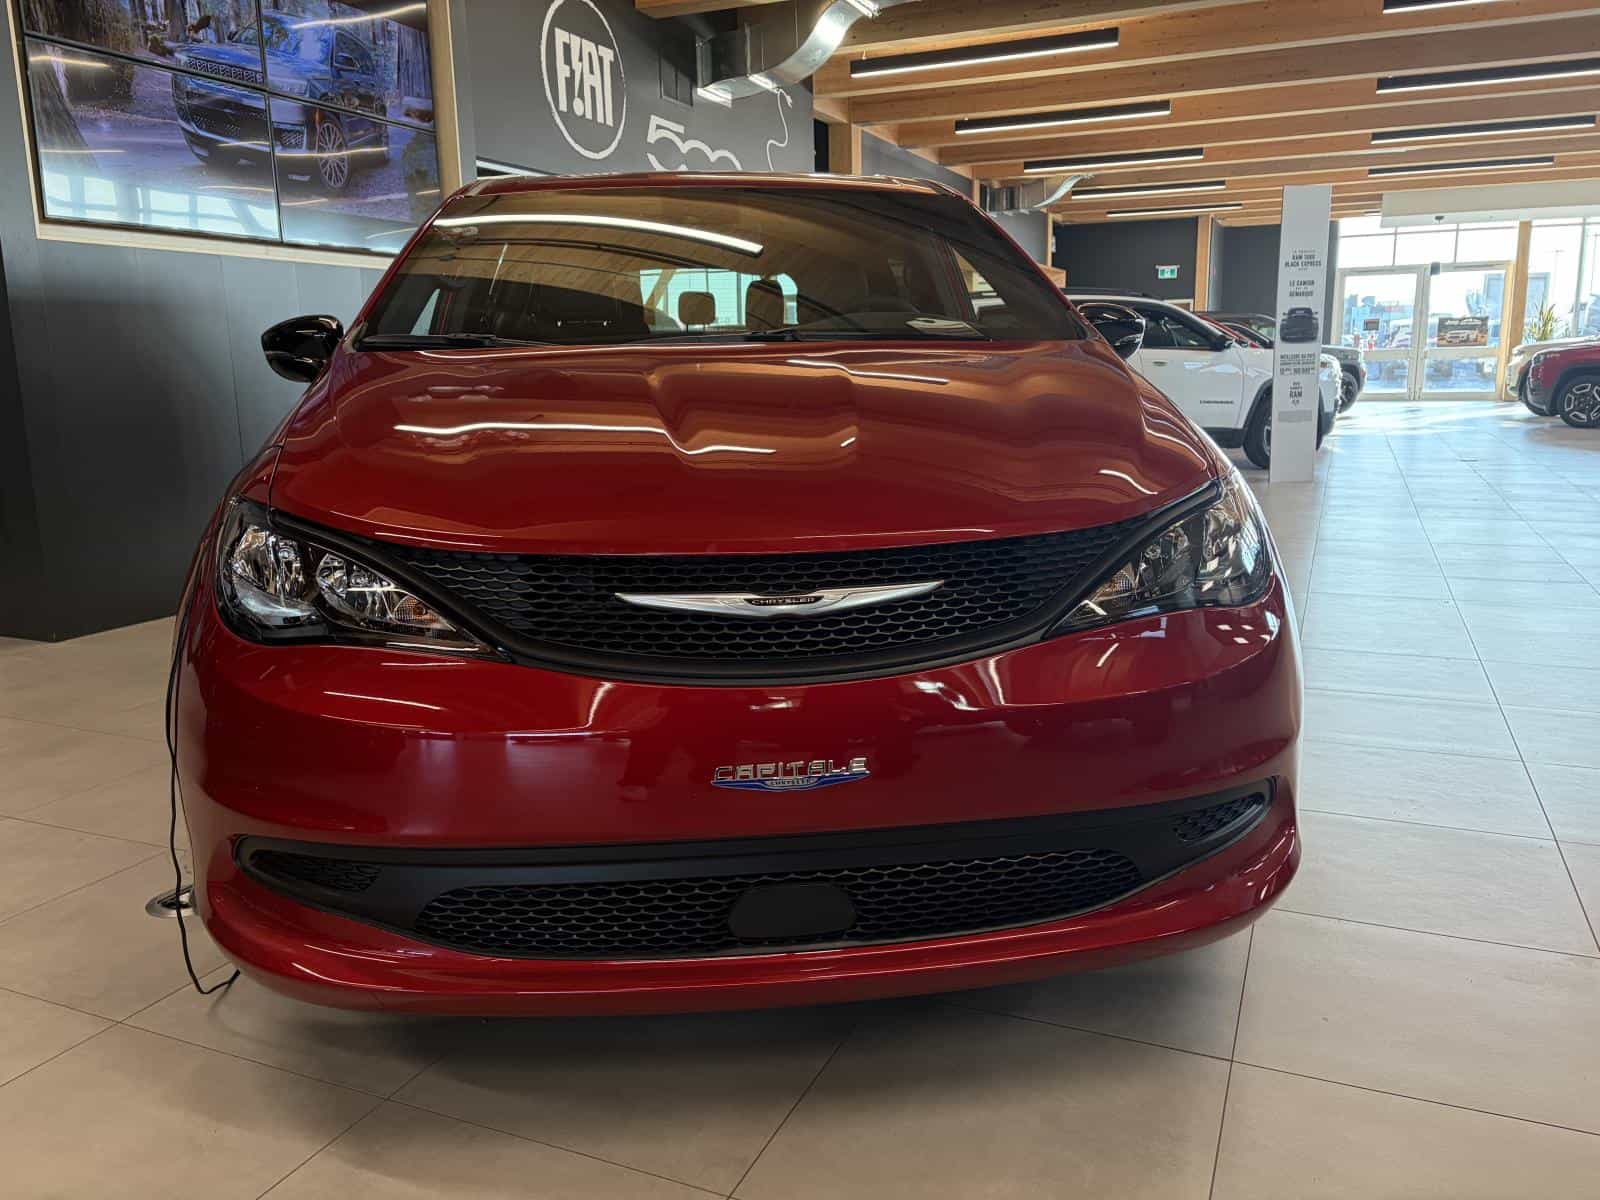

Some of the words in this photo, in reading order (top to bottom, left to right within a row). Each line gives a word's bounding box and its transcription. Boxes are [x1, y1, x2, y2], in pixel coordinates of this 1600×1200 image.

[554, 27, 615, 128] FIAT
[1289, 390, 1303, 398] RAM
[714, 757, 868, 782] CAPITALE
